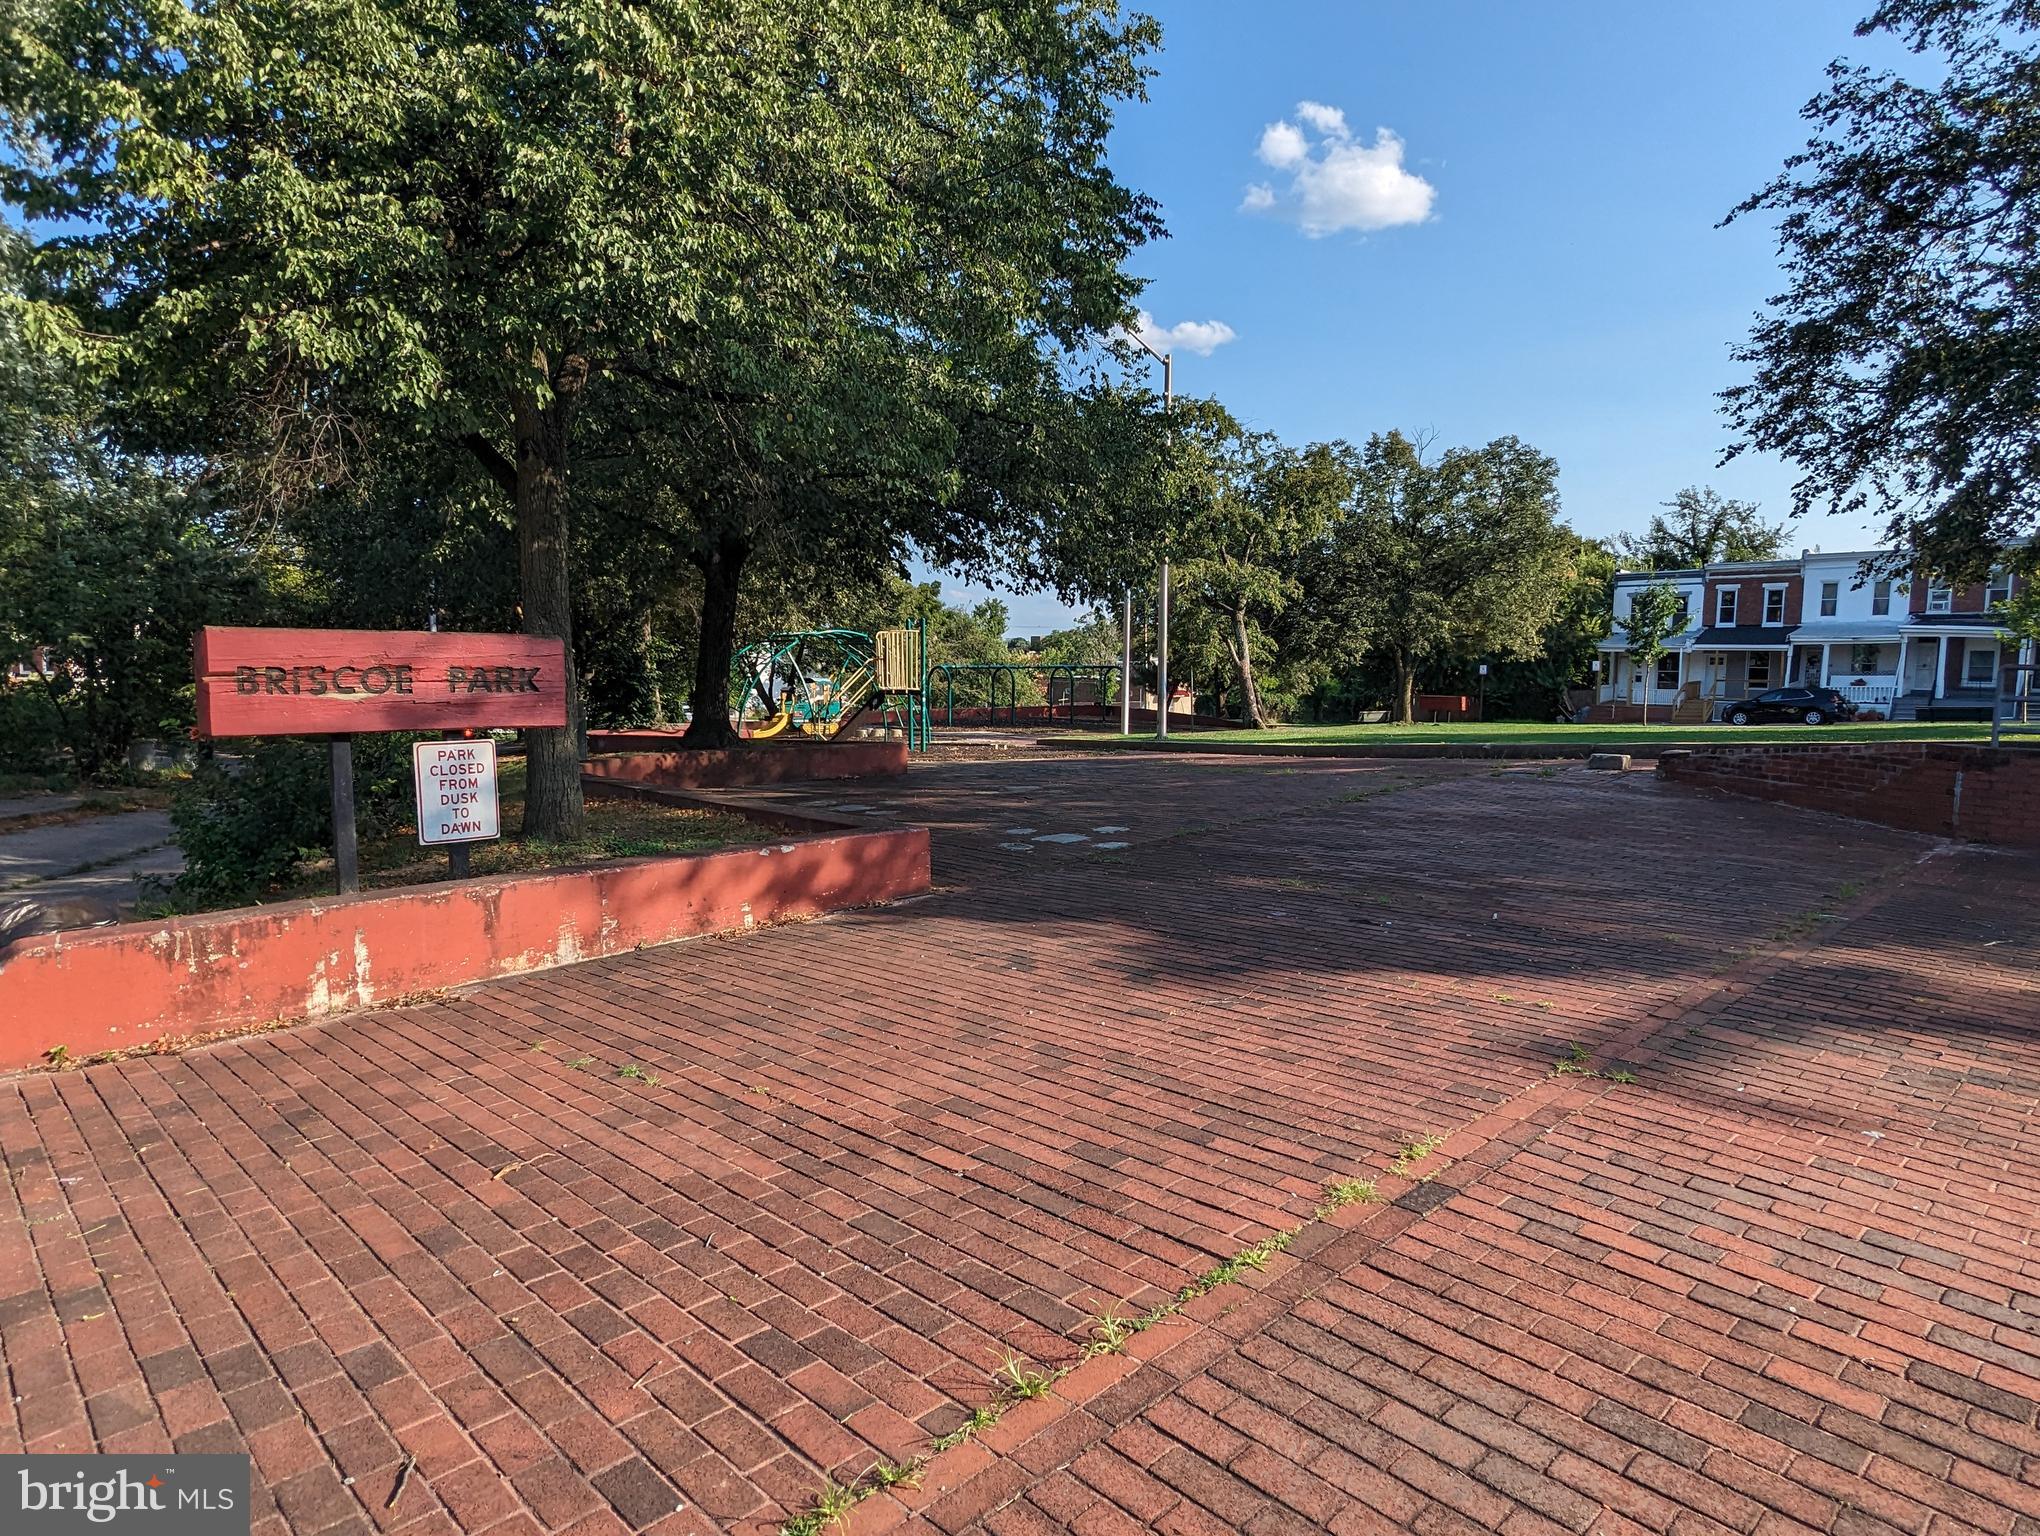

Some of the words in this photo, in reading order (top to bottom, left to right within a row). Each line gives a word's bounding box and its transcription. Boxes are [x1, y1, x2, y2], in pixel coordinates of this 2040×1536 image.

[236, 666, 413, 695] BRISCOE
[448, 666, 541, 693] PARK
[437, 750, 476, 761] PARK
[430, 763, 485, 777] CLOSED
[439, 778, 479, 791] FROM
[440, 793, 478, 806] DUSK
[453, 808, 469, 819] TO
[441, 821, 481, 835] DAWN
